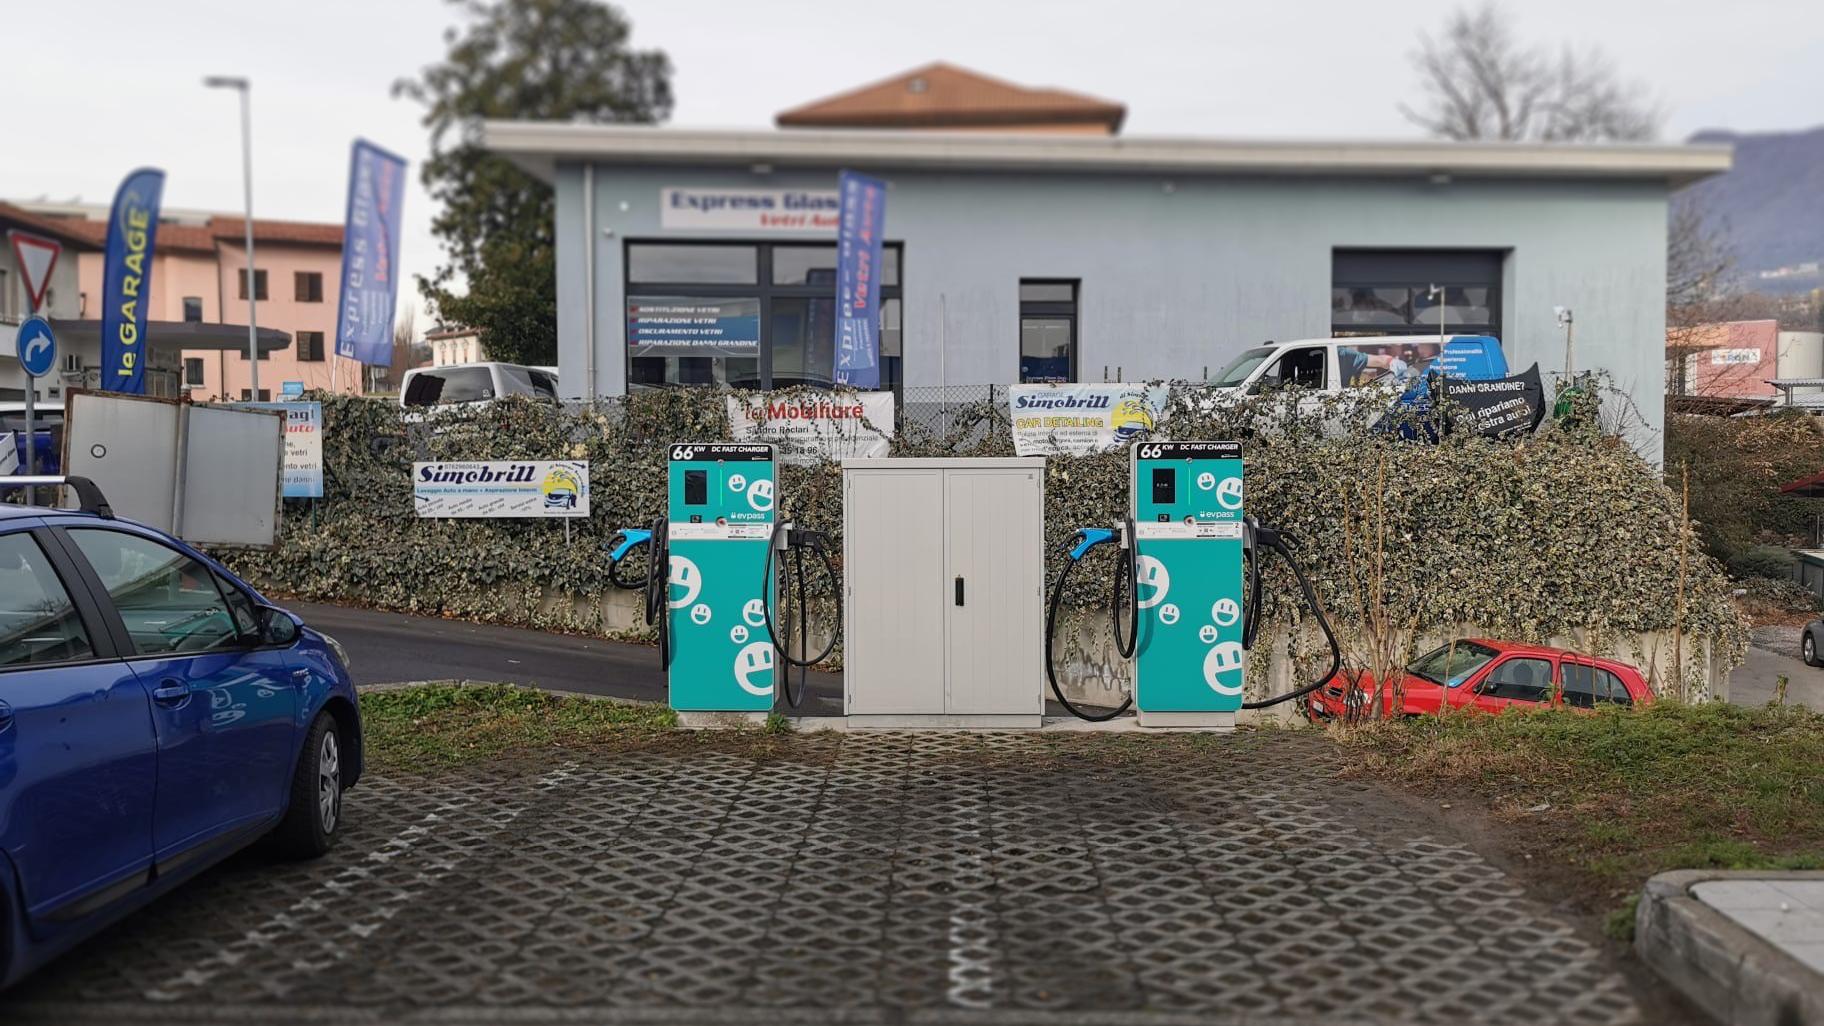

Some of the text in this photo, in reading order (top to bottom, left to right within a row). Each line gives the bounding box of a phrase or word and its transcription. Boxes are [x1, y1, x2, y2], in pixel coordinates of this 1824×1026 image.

[671, 190, 839, 212] Express Glas
[118, 207, 149, 376] le GARAGE
[1449, 381, 1525, 394] DANNI GRANDINE?
[1015, 394, 1110, 409] Simobrill
[1478, 397, 1525, 417] ripariamo
[289, 409, 314, 421] agl
[1478, 415, 1505, 430] ostra
[1016, 417, 1104, 429] CAR DETAILING
[672, 446, 694, 460] 66
[1140, 444, 1162, 458] 66
[418, 464, 537, 485] Simobrill
